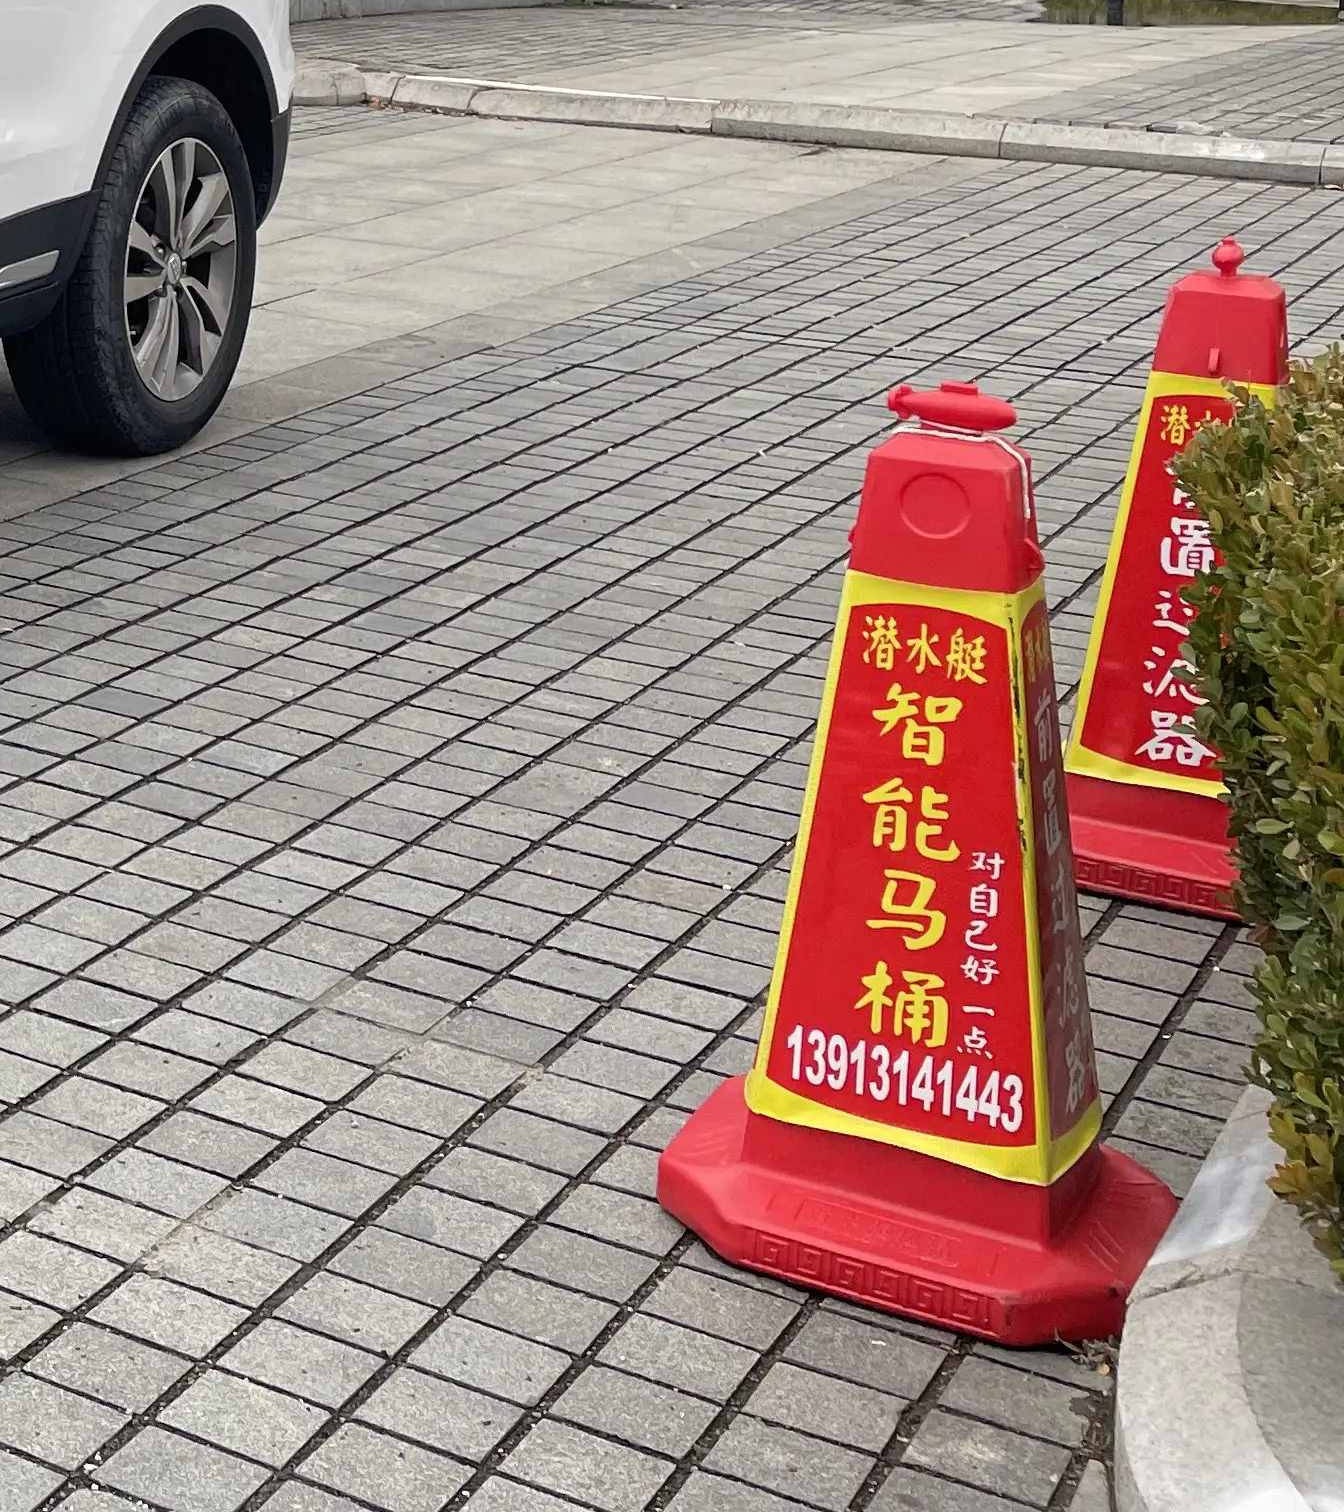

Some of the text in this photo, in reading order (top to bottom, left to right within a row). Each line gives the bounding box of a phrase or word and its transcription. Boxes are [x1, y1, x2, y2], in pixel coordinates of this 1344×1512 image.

[862, 615, 988, 684] 潜水艇
[854, 682, 964, 1048] 智能马桶
[956, 851, 1005, 1059] 对自己好一点
[787, 1024, 1024, 1133] 13913141443
